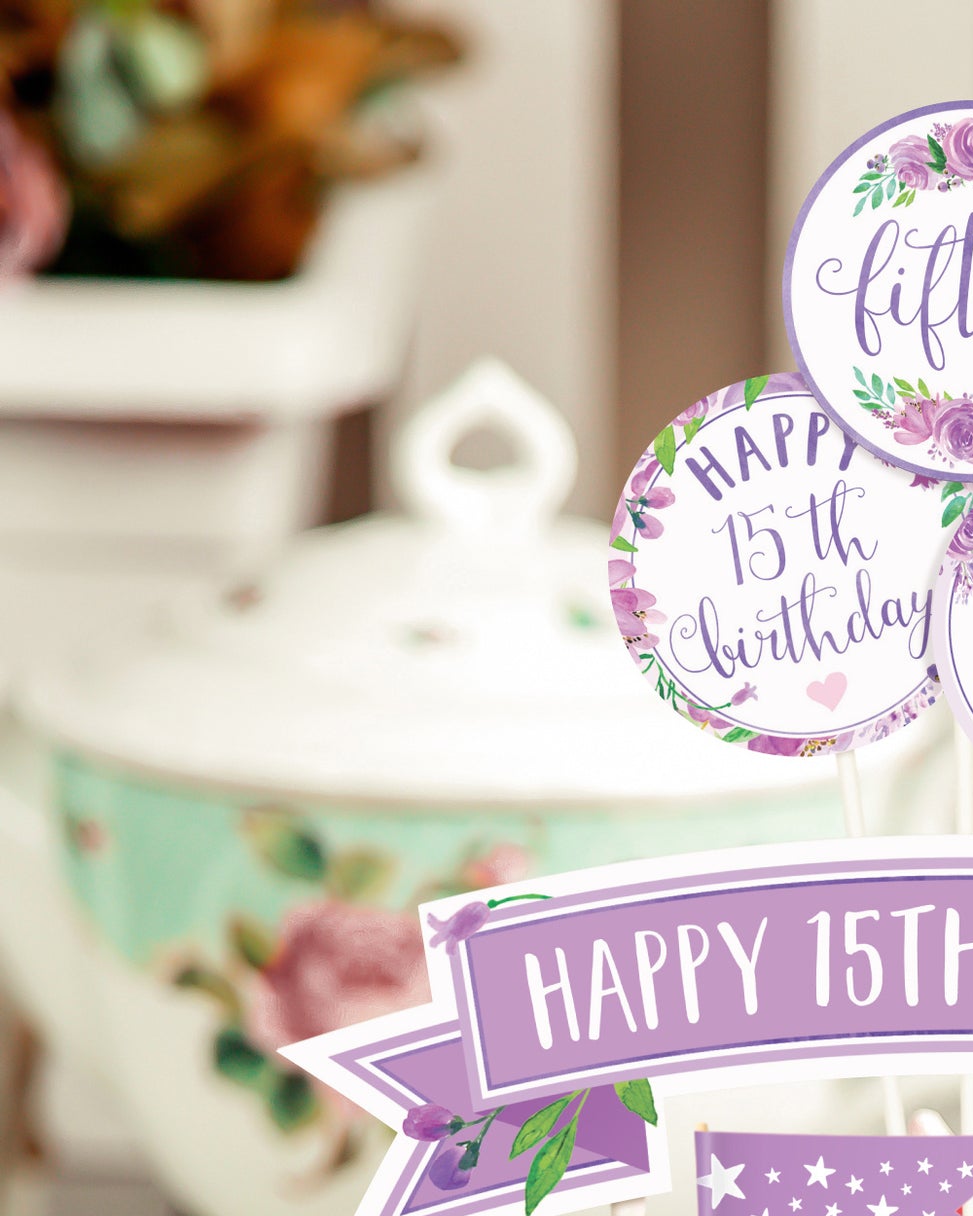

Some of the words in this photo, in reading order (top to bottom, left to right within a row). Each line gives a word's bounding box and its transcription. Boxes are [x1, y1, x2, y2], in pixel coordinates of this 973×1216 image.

[685, 412, 858, 501] HAPPY
[669, 569, 933, 679] birthday
[524, 916, 768, 1050] HAPPY
